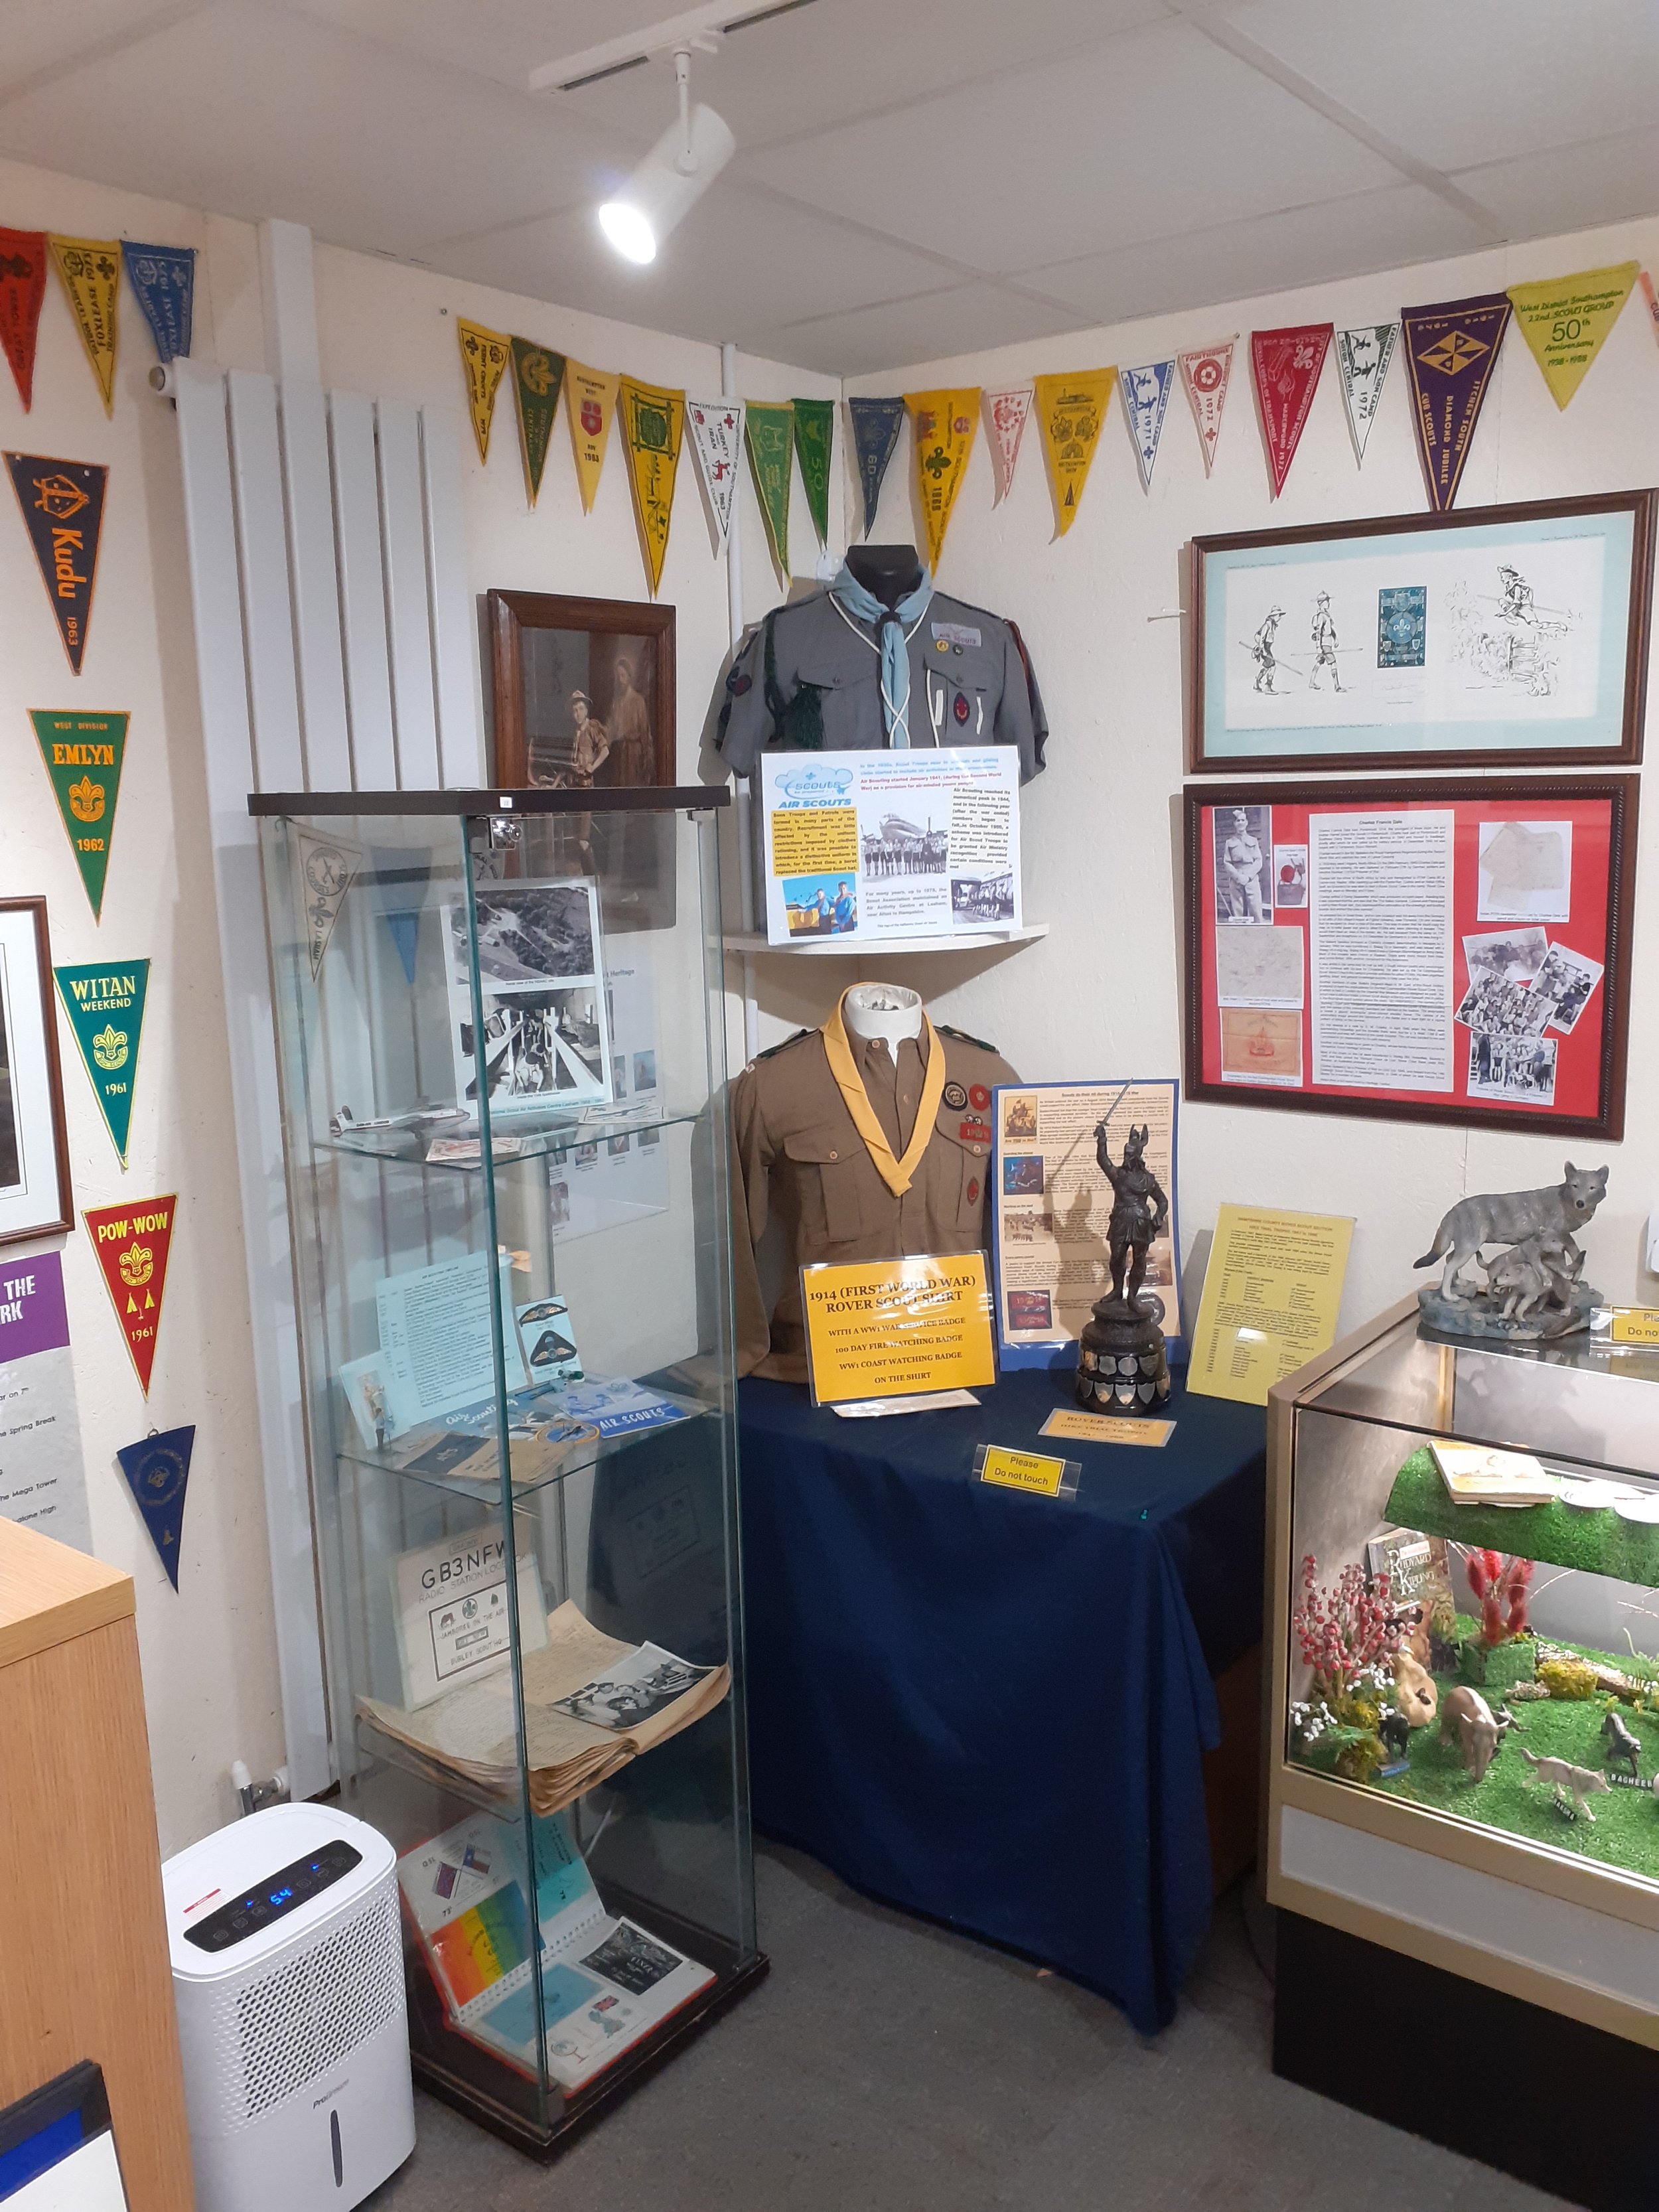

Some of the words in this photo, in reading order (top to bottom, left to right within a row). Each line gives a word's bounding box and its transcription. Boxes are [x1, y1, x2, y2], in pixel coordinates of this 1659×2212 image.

[89, 286, 106, 347] FOXLEASE
[1551, 319, 1591, 342] 50th
[1344, 366, 1354, 397] CENTRAL
[1358, 391, 1368, 419] 1972
[1368, 394, 1377, 417] CAMP
[1421, 393, 1431, 411] CUB
[1465, 380, 1480, 415] ITCHEN
[1265, 400, 1277, 442] TRANSPORT
[1424, 412, 1436, 447] SCOUTS
[1444, 396, 1453, 443] DIAMOND
[708, 427, 717, 449] IRAN
[717, 422, 729, 458] TURKEY
[1287, 421, 1299, 449] SCOUTS
[1455, 419, 1469, 452] SOUTH
[1441, 449, 1450, 485] JUBILEE
[52, 528, 87, 599] Kudu
[68, 617, 78, 646] 1963
[52, 743, 114, 765] EMLYN
[802, 798, 851, 808] SCOUTS
[77, 839, 104, 851] 1962
[313, 930, 324, 960] LASHAM
[70, 976, 135, 1001] WITAN
[80, 998, 131, 1012] WEEKEND
[105, 1082, 127, 1096] 1961
[98, 1211, 168, 1243] POW-WOW
[3, 1275, 36, 1300] THE
[810, 1291, 837, 1301] 1914
[839, 1284, 884, 1299] (FIRST
[887, 1279, 937, 1293] WORLD
[939, 1275, 975, 1289] WAR)
[0, 1301, 23, 1325] RK
[826, 1300, 872, 1313] ROVER
[875, 1296, 917, 1308] SCOUT
[922, 1291, 964, 1304] SHIRT
[131, 1326, 153, 1343] 1961
[828, 1328, 851, 1337] WITH
[938, 1317, 966, 1326] BADGE
[1628, 1327, 1642, 1336] Do
[850, 1344, 867, 1353] DAY
[889, 1337, 934, 1349] WATCHING
[936, 1335, 963, 1344] BADGE
[861, 1359, 887, 1368] COAST
[889, 1354, 933, 1365] WATCHING
[935, 1351, 962, 1361] BADGE
[888, 1374, 904, 1383] THE
[906, 1372, 932, 1381] SHIRT
[9, 1422, 33, 1435] Spring
[35, 1416, 56, 1427] Break
[599, 1415, 618, 1432] AIR
[622, 1406, 665, 1426] SCOUTS
[1067, 1416, 1104, 1425] ROVER
[1010, 1456, 1039, 1469] Please
[12, 1487, 33, 1497] Mega
[36, 1478, 58, 1490] Tower
[994, 1467, 1007, 1478] Do
[1008, 1471, 1023, 1481] not
[1024, 1473, 1048, 1486] touch
[1387, 1550, 1431, 1576] RUDYARD
[419, 1585, 445, 1603] RADIO
[451, 1572, 483, 1590] STATION
[1400, 1568, 1434, 1596] KIPLING
[441, 1623, 470, 1639] JAMBOREE
[496, 1609, 505, 1617] AIR
[451, 1651, 473, 1666] BURLEY
[476, 1643, 492, 1655] SCOUT
[269, 1887, 293, 1905] 54
[313, 2079, 349, 2109] ProBreeze
